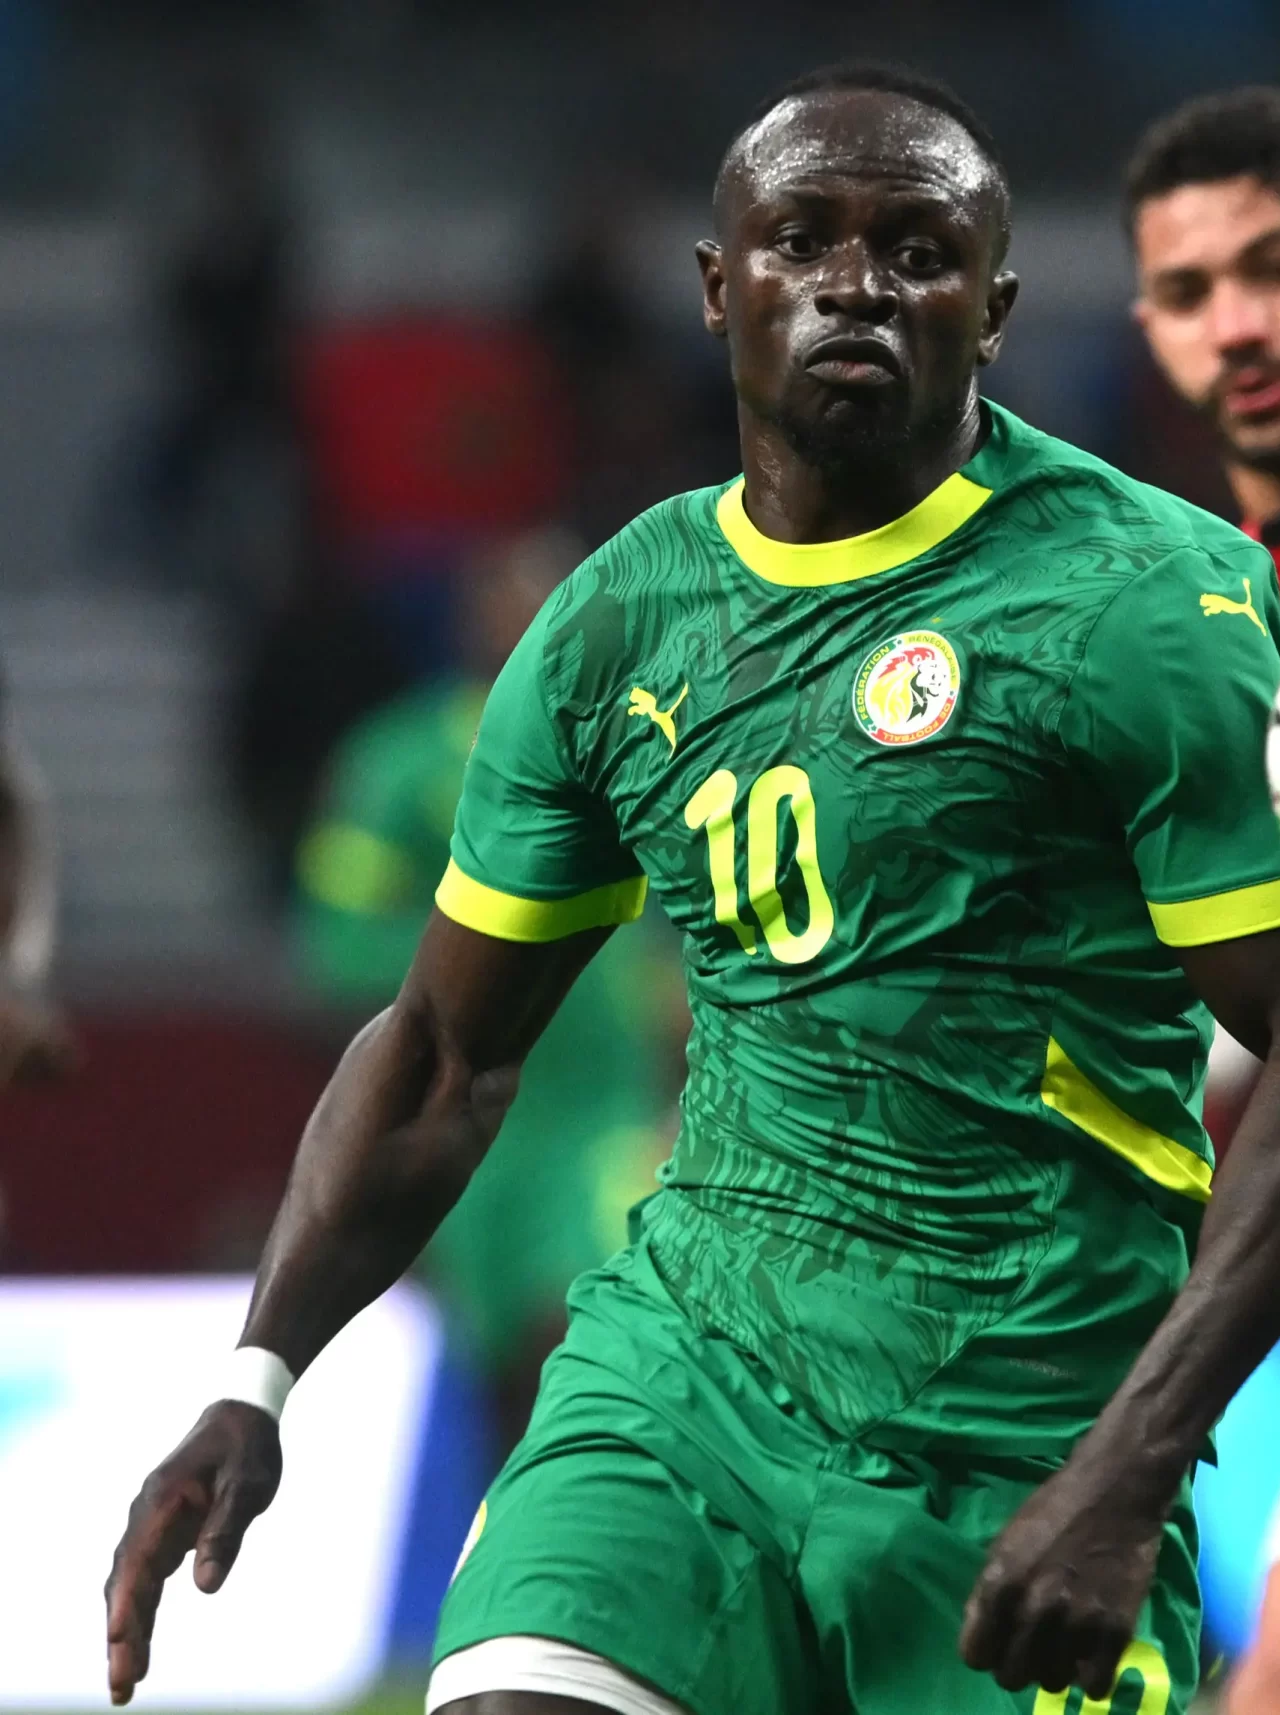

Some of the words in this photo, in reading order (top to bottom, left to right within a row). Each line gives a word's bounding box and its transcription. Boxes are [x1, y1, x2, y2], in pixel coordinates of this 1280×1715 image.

[940, 703, 951, 719] DE
[883, 721, 940, 742] FOOTBALL
[684, 765, 834, 964] 10
